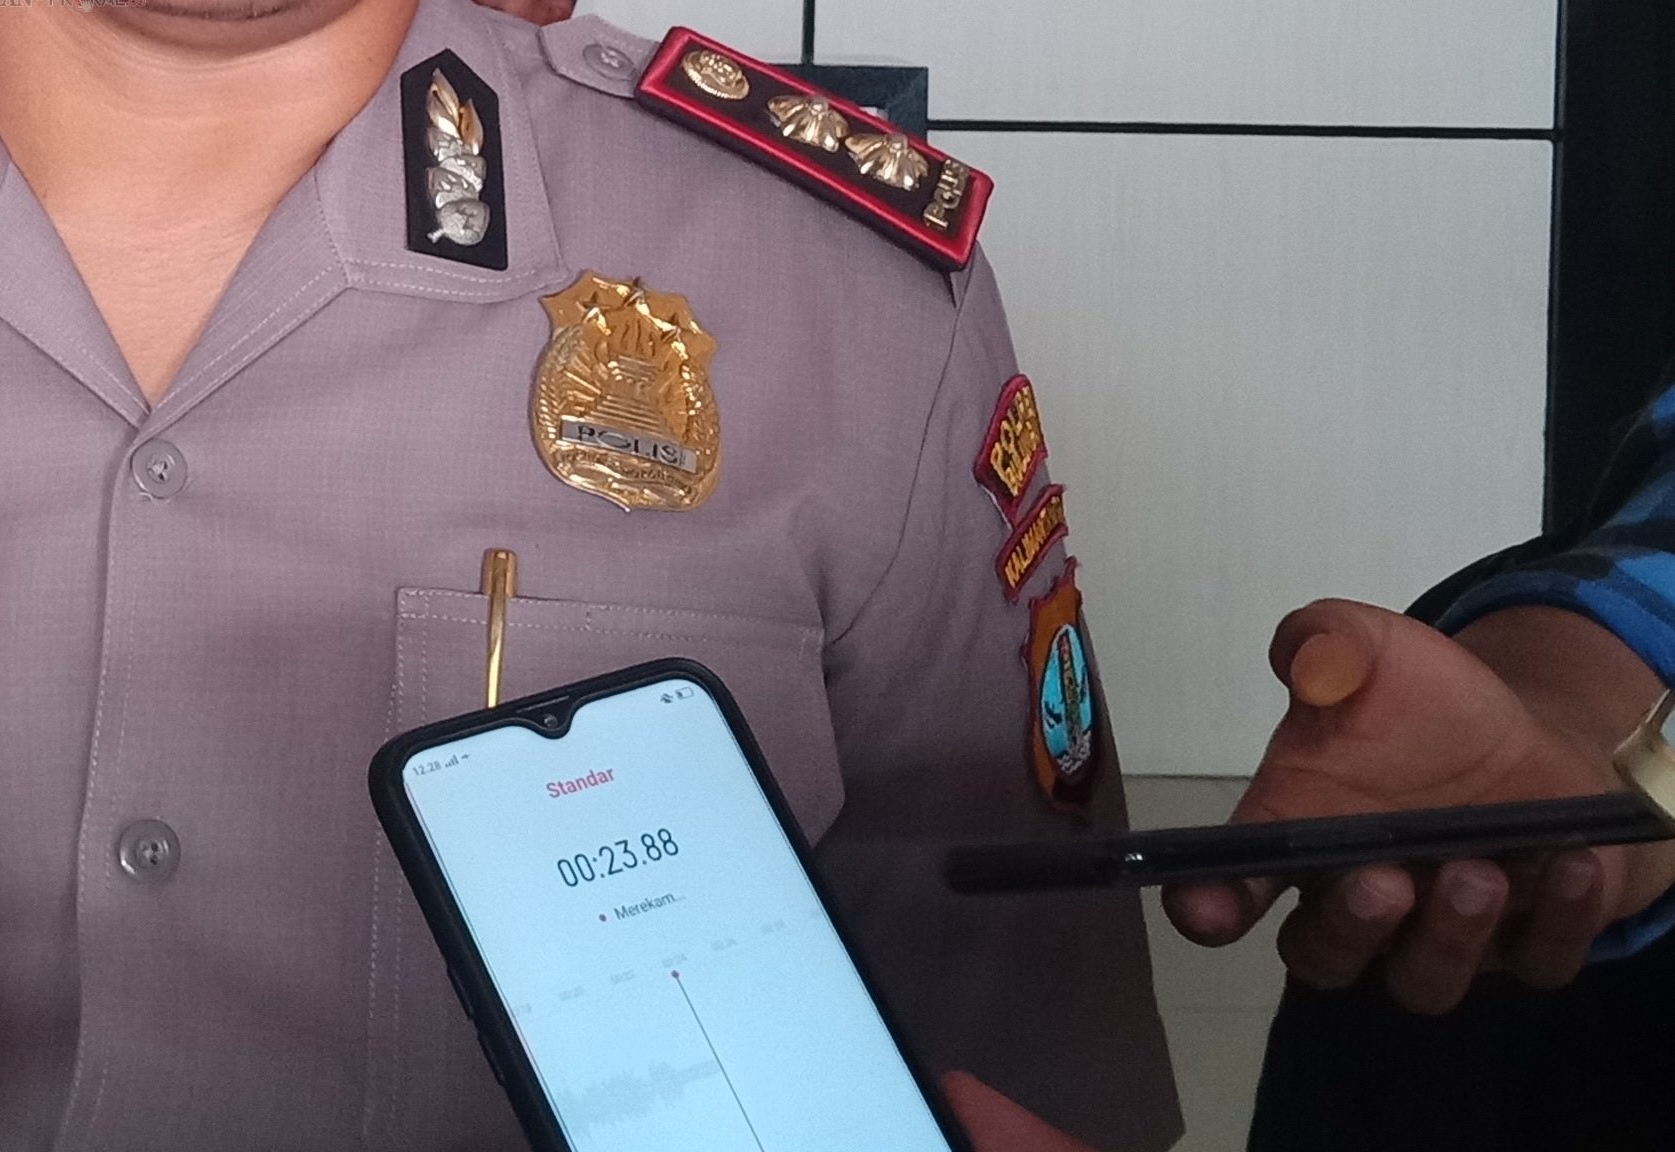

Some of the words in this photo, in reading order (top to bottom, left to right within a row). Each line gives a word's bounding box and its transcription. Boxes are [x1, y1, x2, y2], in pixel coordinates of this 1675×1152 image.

[577, 424, 679, 464] POLIS
[546, 768, 615, 799] Standar
[557, 828, 679, 888] 00:23.88
